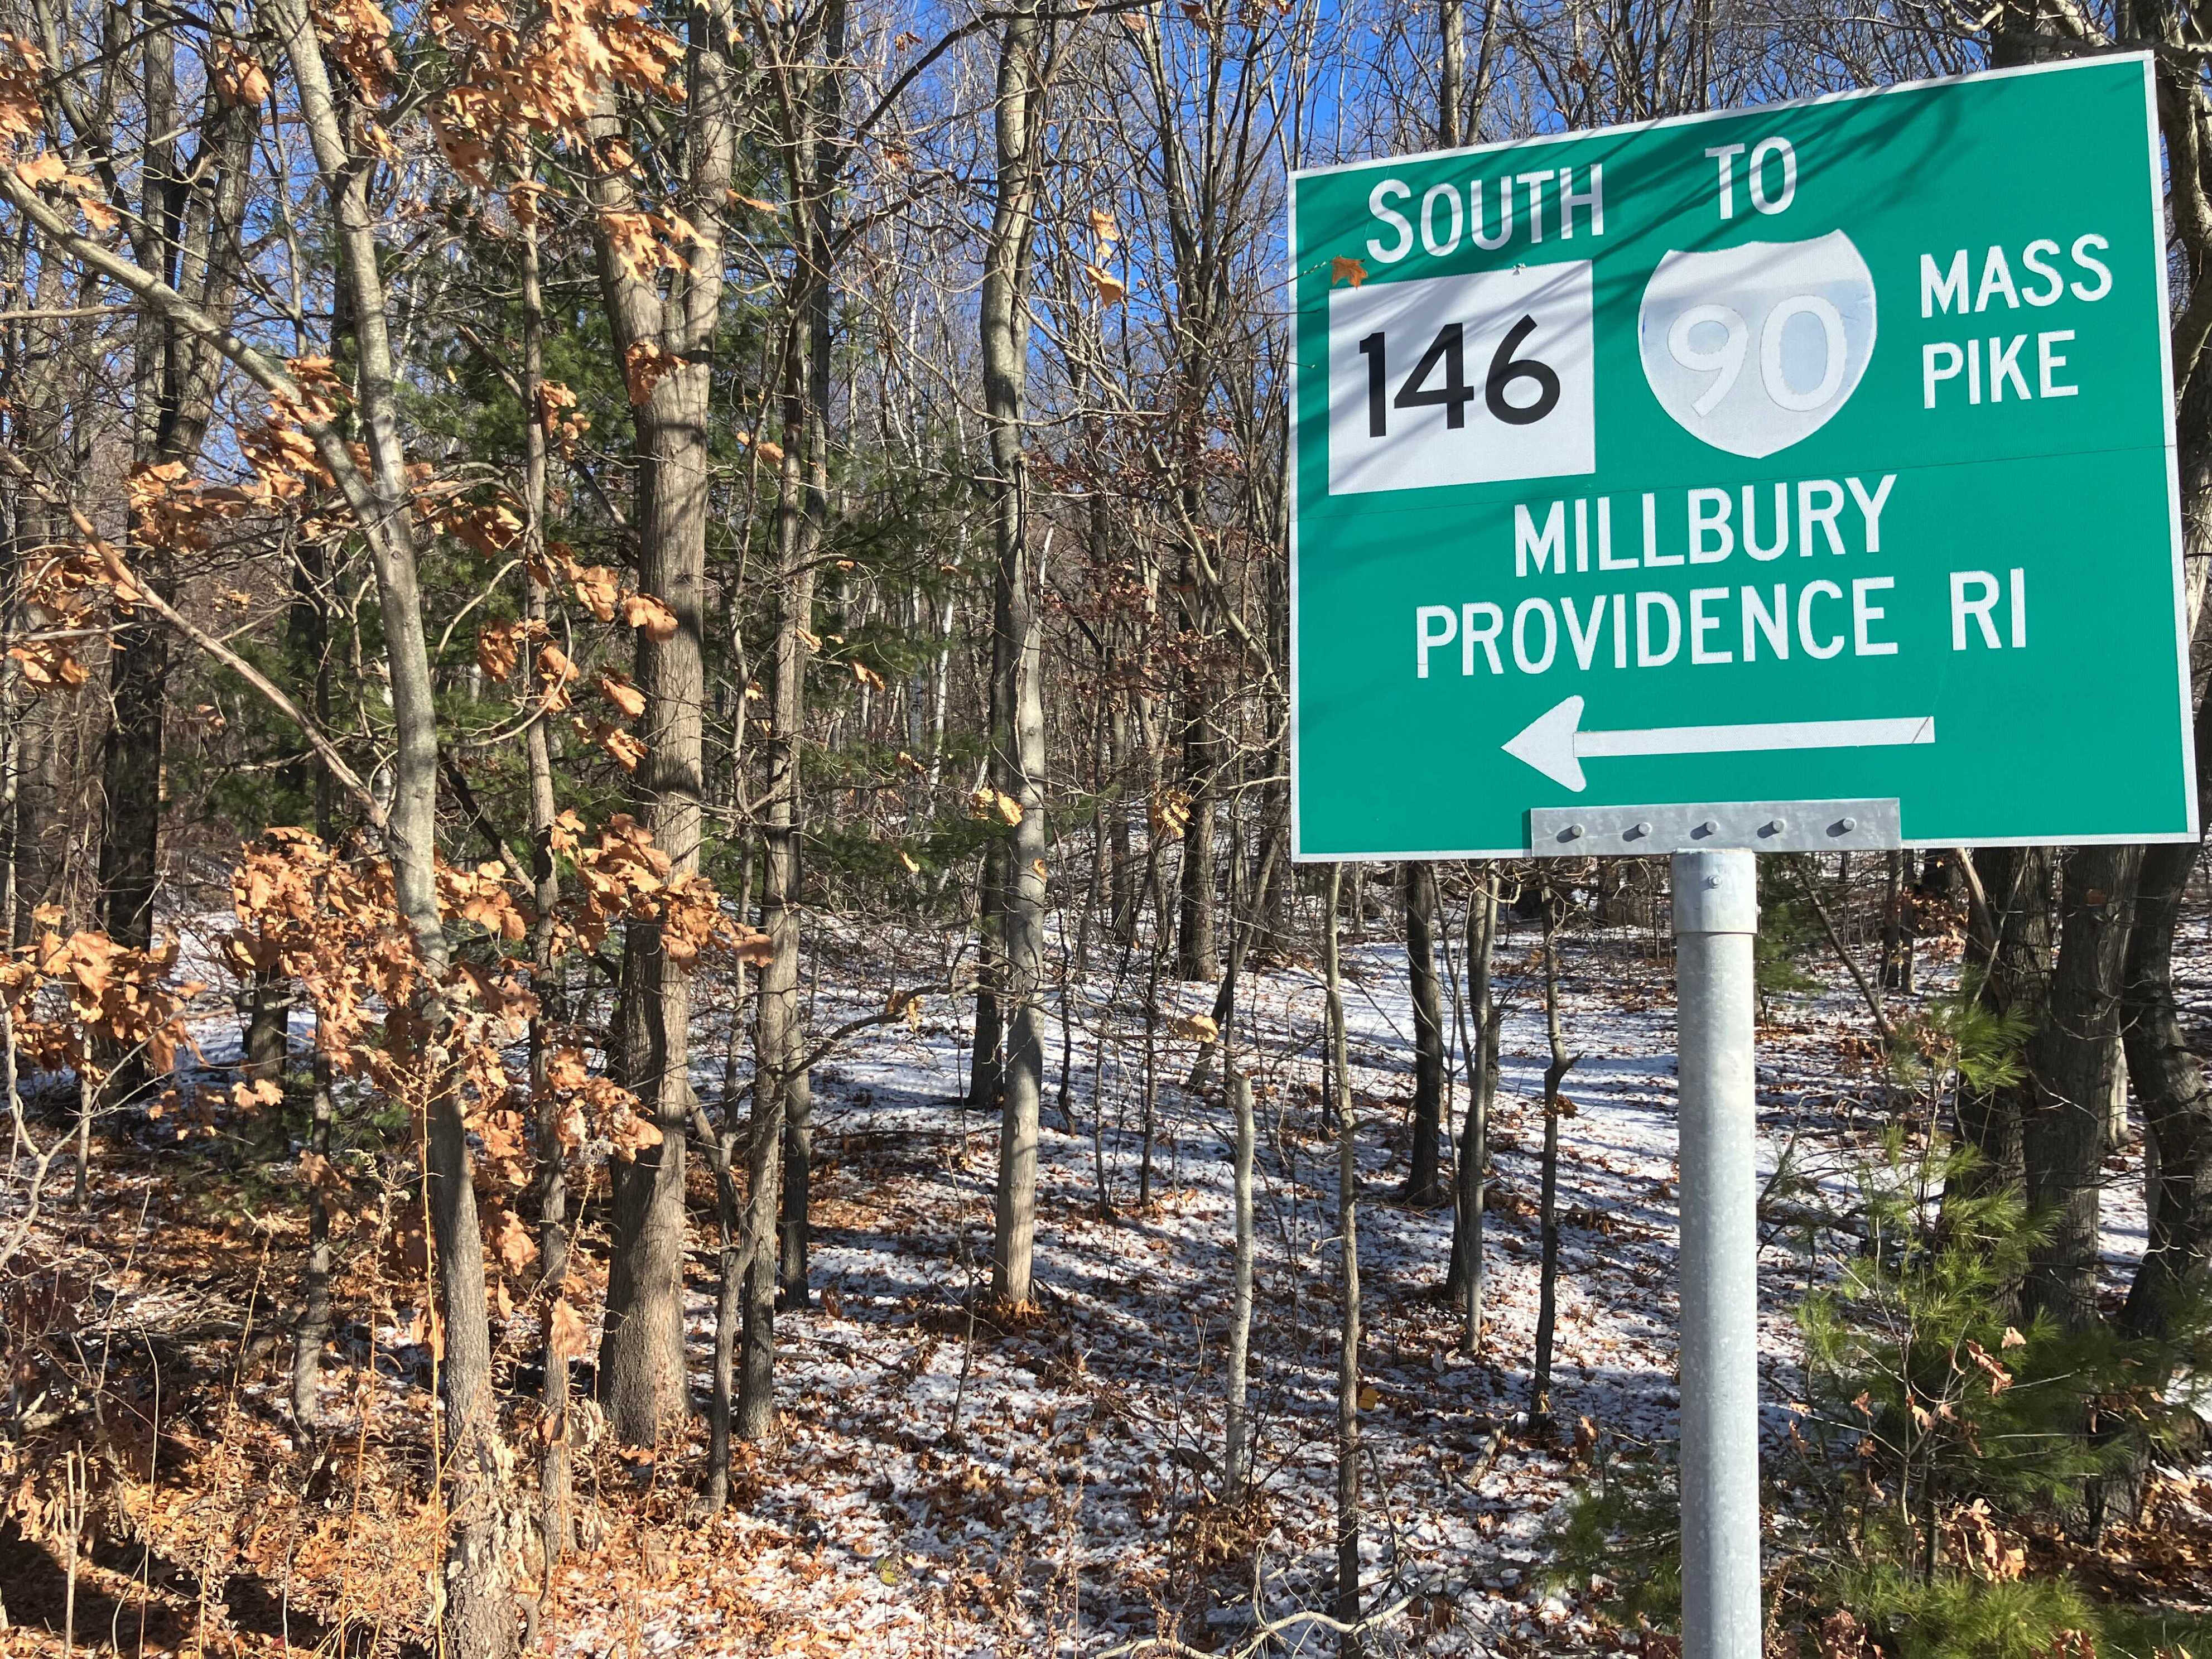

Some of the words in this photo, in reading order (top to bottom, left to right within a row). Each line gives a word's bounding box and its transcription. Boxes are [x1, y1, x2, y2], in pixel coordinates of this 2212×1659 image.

[1366, 163, 1604, 263] SOUTH
[1705, 137, 1797, 220] TO
[1920, 234, 2113, 318] MASS
[1359, 314, 1560, 438] 146
[1667, 294, 1847, 418] 90
[1922, 330, 2079, 409] PIKE
[1514, 474, 1897, 577] MILLBURY
[1416, 576, 1899, 678] PROVIDENCE
[1951, 567, 2027, 651] RI
